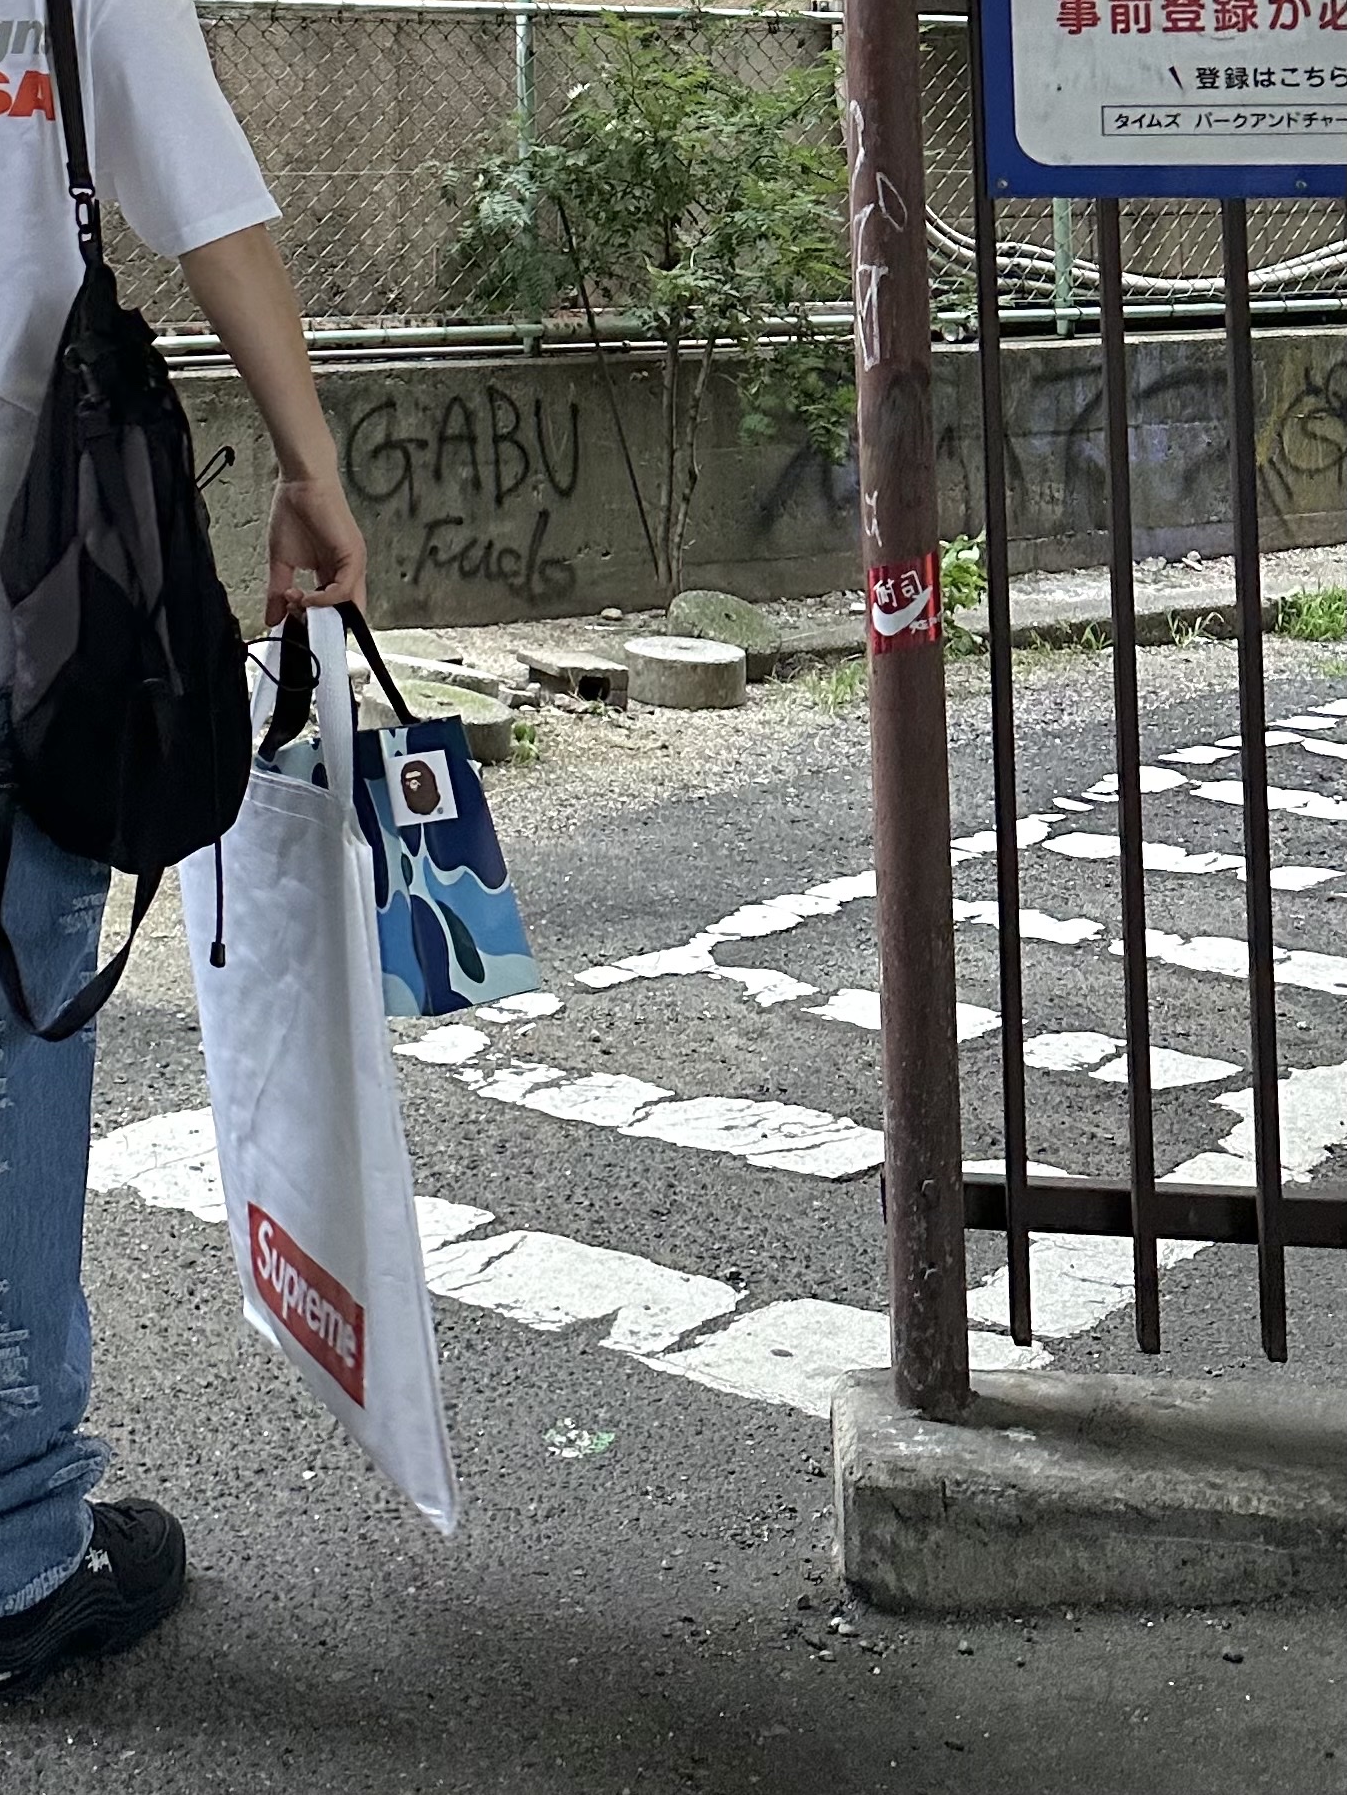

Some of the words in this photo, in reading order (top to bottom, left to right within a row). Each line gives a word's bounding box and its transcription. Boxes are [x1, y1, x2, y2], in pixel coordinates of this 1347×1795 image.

[1195, 65, 1347, 89] 登録はこちら
[1114, 112, 1181, 130] タイムズ
[348, 384, 580, 518] GABU
[256, 1219, 358, 1368] Supreme
